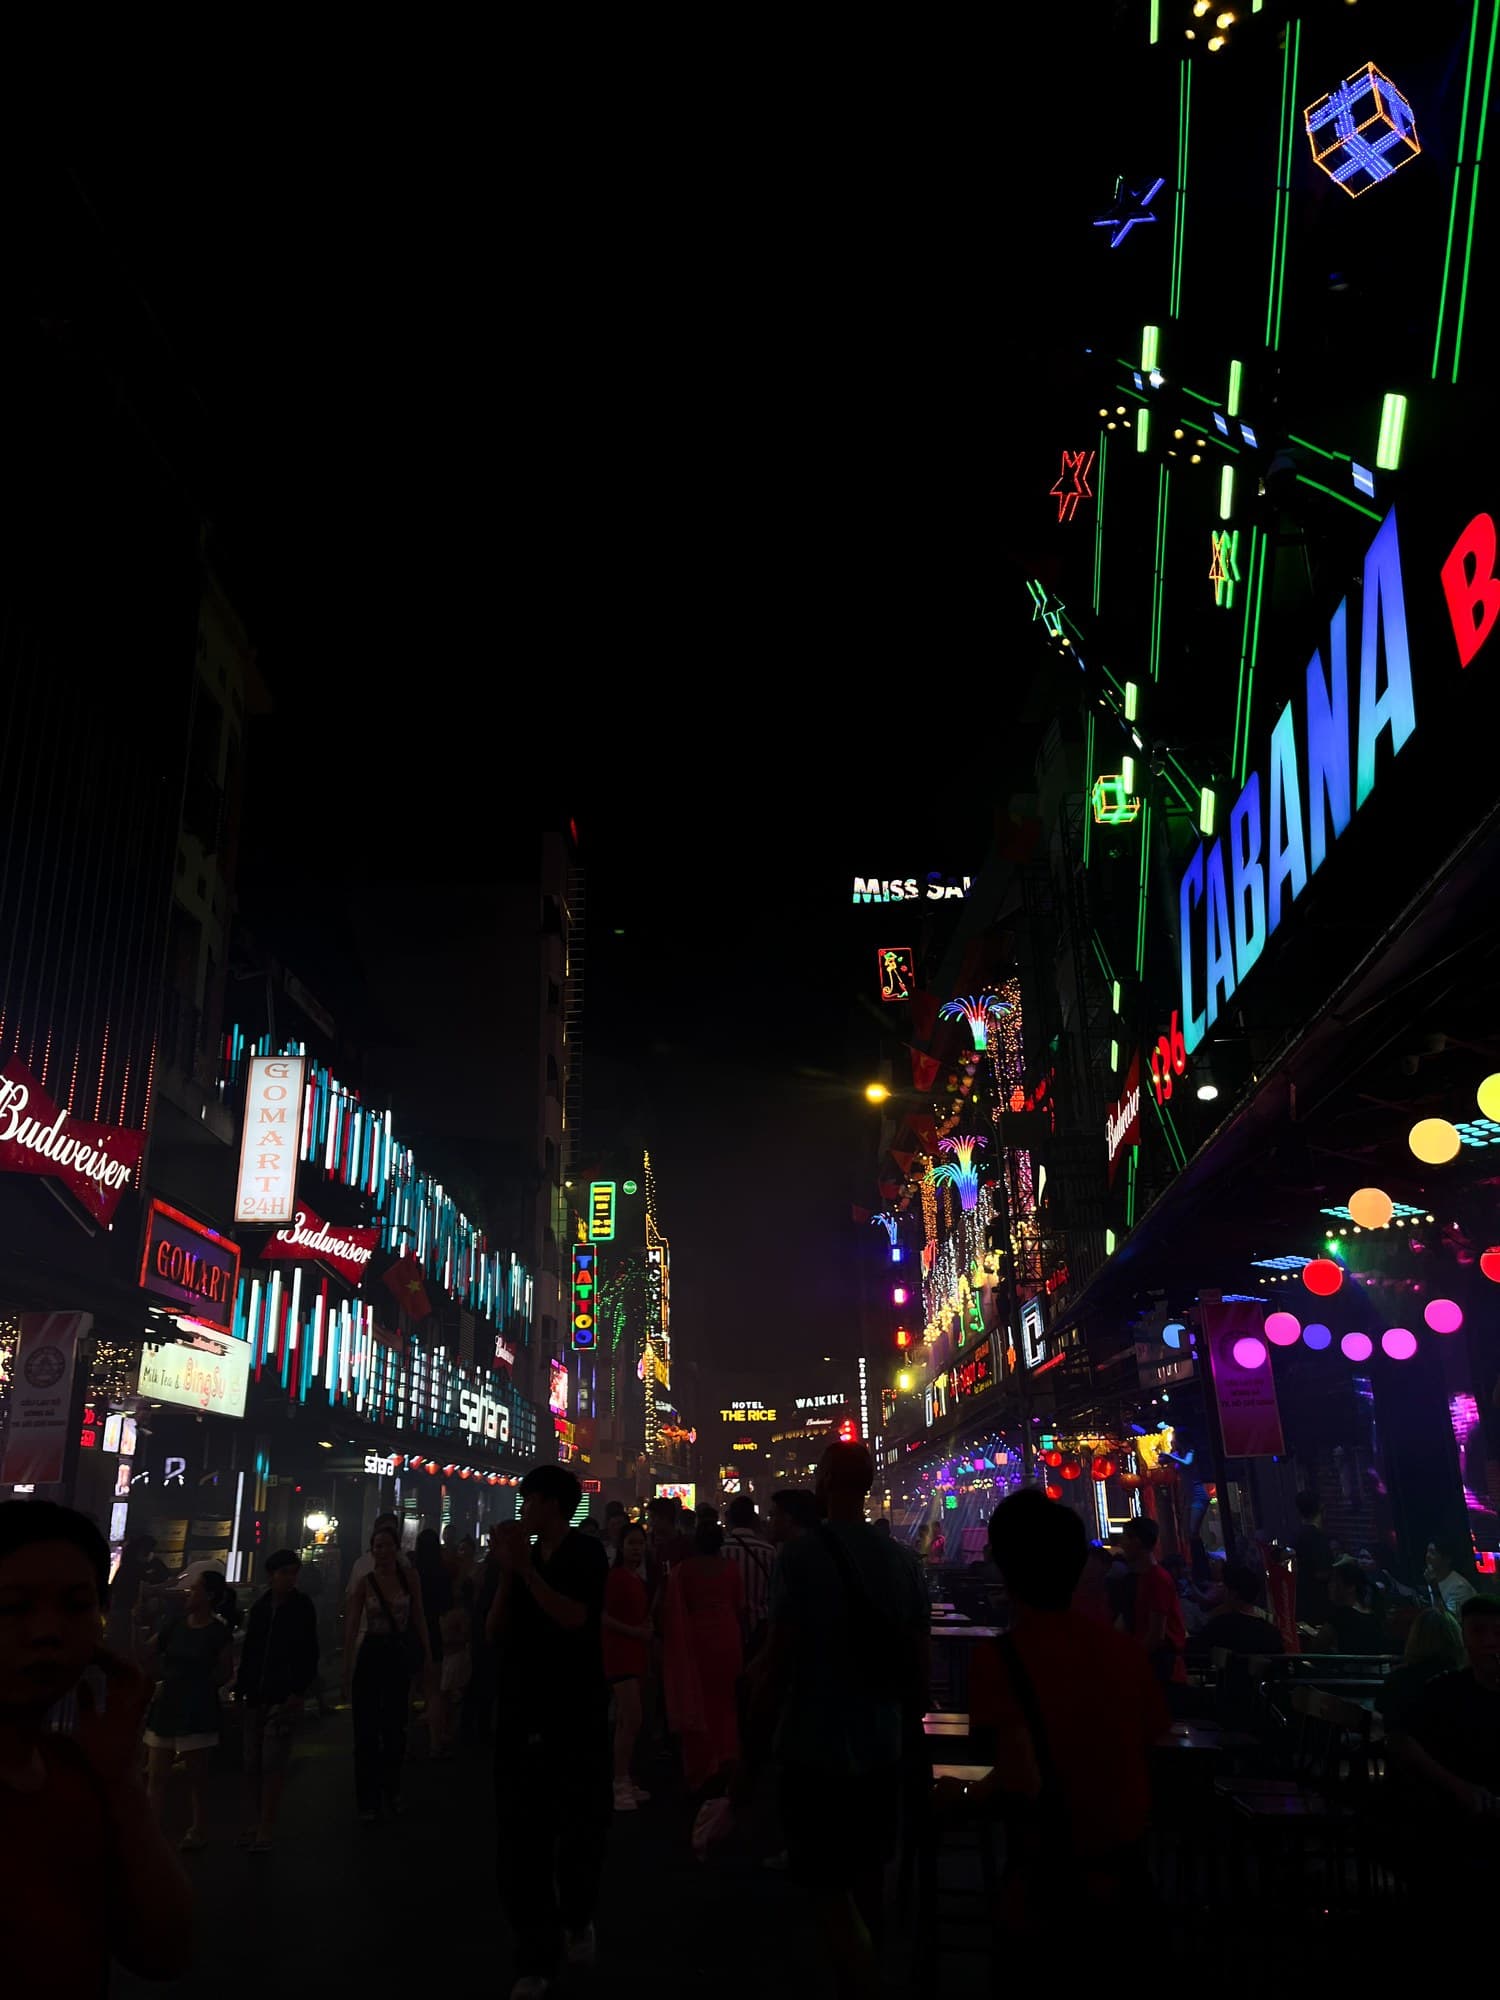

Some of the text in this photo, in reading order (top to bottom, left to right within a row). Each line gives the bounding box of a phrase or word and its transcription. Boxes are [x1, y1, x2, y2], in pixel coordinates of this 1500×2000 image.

[1179, 501, 1416, 1056] CABANA
[0, 1074, 132, 1190] Budweiser
[257, 1062, 290, 1195] GOMART
[242, 1196, 287, 1217] 24H
[277, 1210, 373, 1265] Budweiser
[157, 1240, 231, 1303] GOMART
[575, 1255, 594, 1345] TATTOO
[143, 1366, 159, 1384] Milk
[160, 1369, 173, 1388] Tea
[794, 1393, 845, 1409] WAIKIKI
[719, 1409, 777, 1422] THE RICE
[731, 1401, 765, 1410] HOTEL
